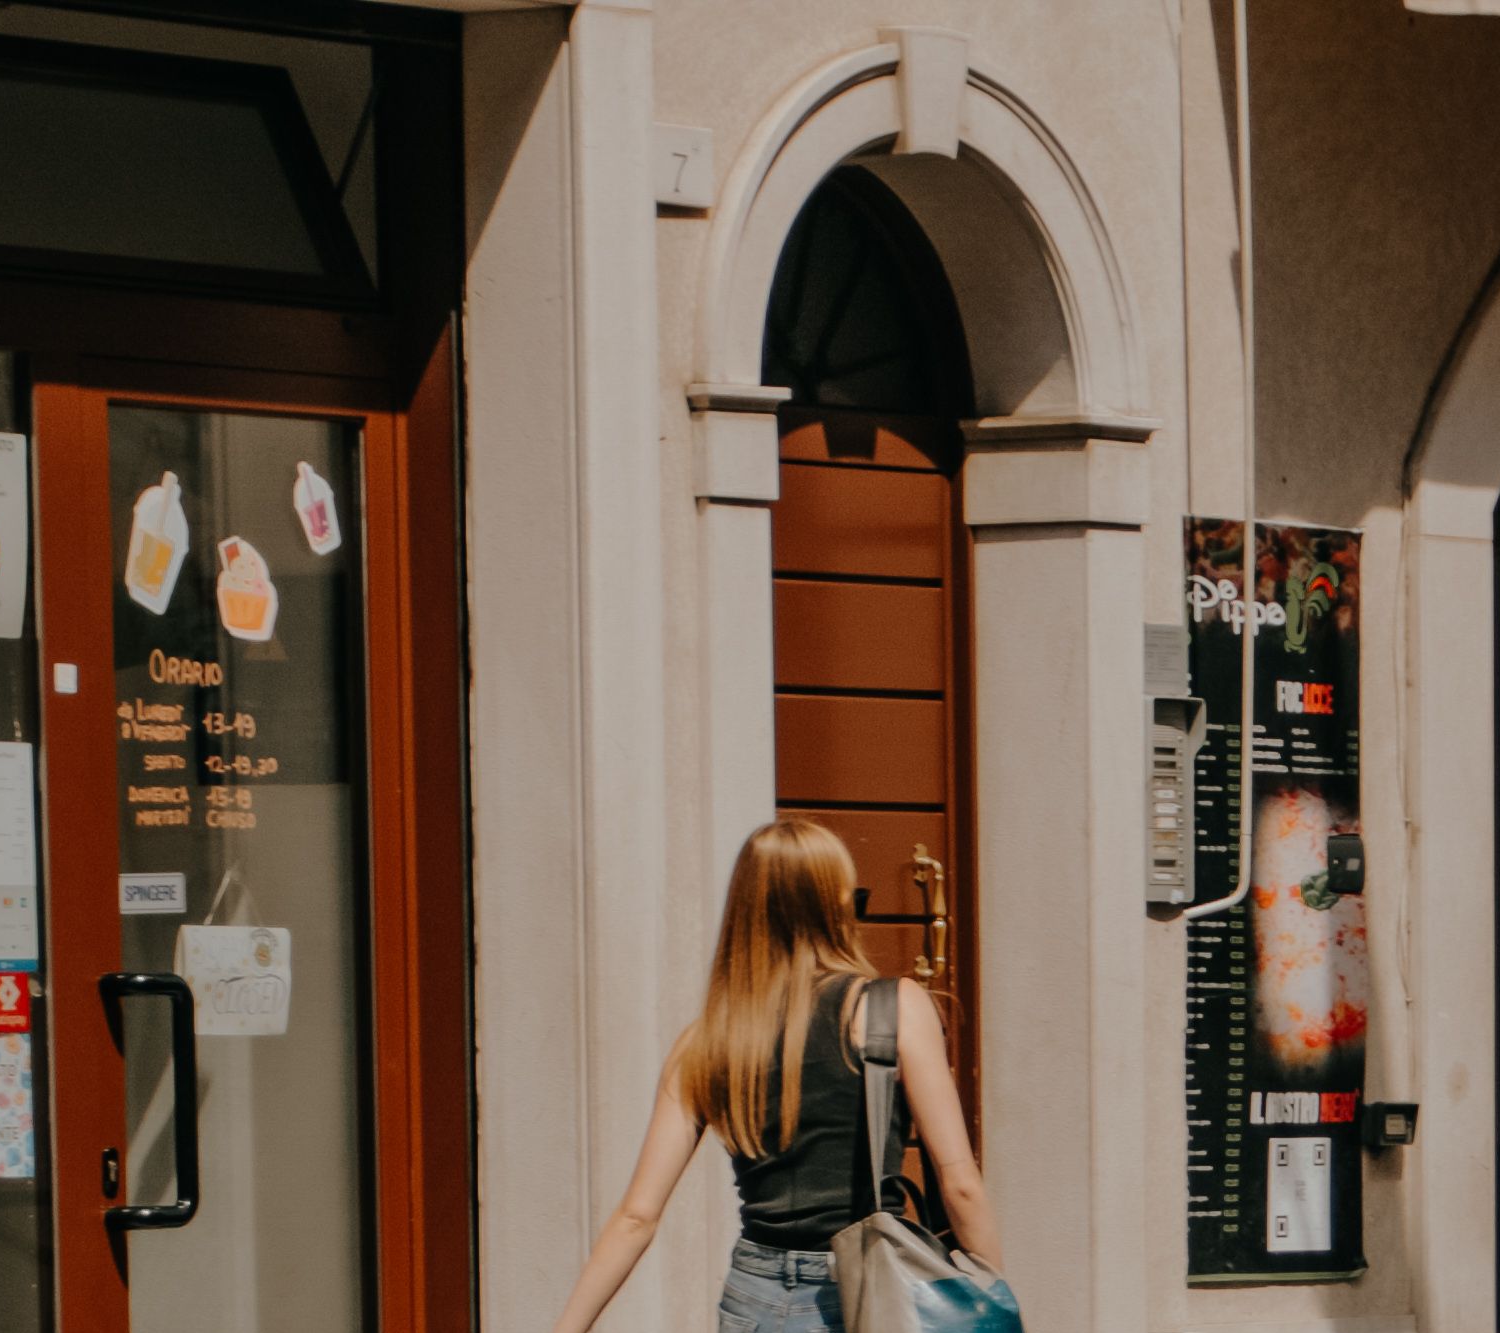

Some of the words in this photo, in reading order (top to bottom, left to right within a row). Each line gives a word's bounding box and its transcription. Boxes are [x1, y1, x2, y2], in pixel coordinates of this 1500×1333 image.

[1187, 573, 1287, 637] Pippo
[150, 648, 224, 687] ORARIO
[125, 884, 178, 901] SPINGERE
